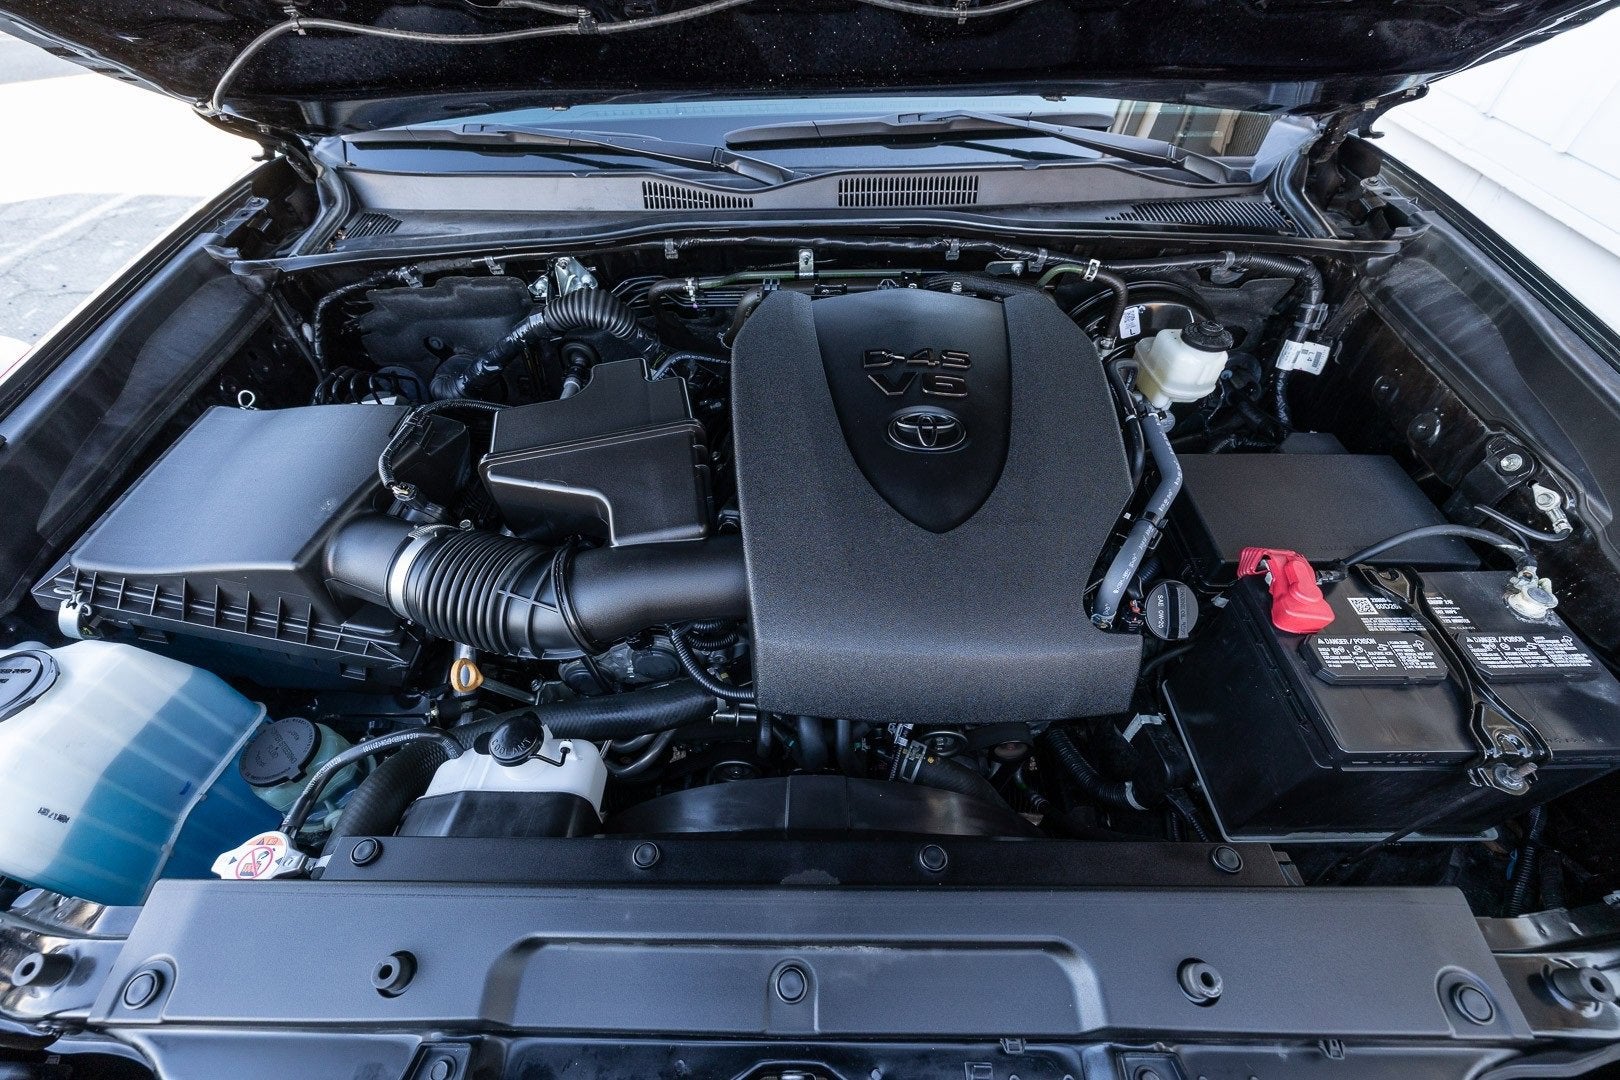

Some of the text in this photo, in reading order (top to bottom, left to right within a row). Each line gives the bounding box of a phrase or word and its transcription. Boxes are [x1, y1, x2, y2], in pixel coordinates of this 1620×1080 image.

[866, 371, 969, 398] V6
[1157, 594, 1165, 607] SAE
[1353, 637, 1377, 645] POISON
[491, 736, 532, 756] COOLANT
